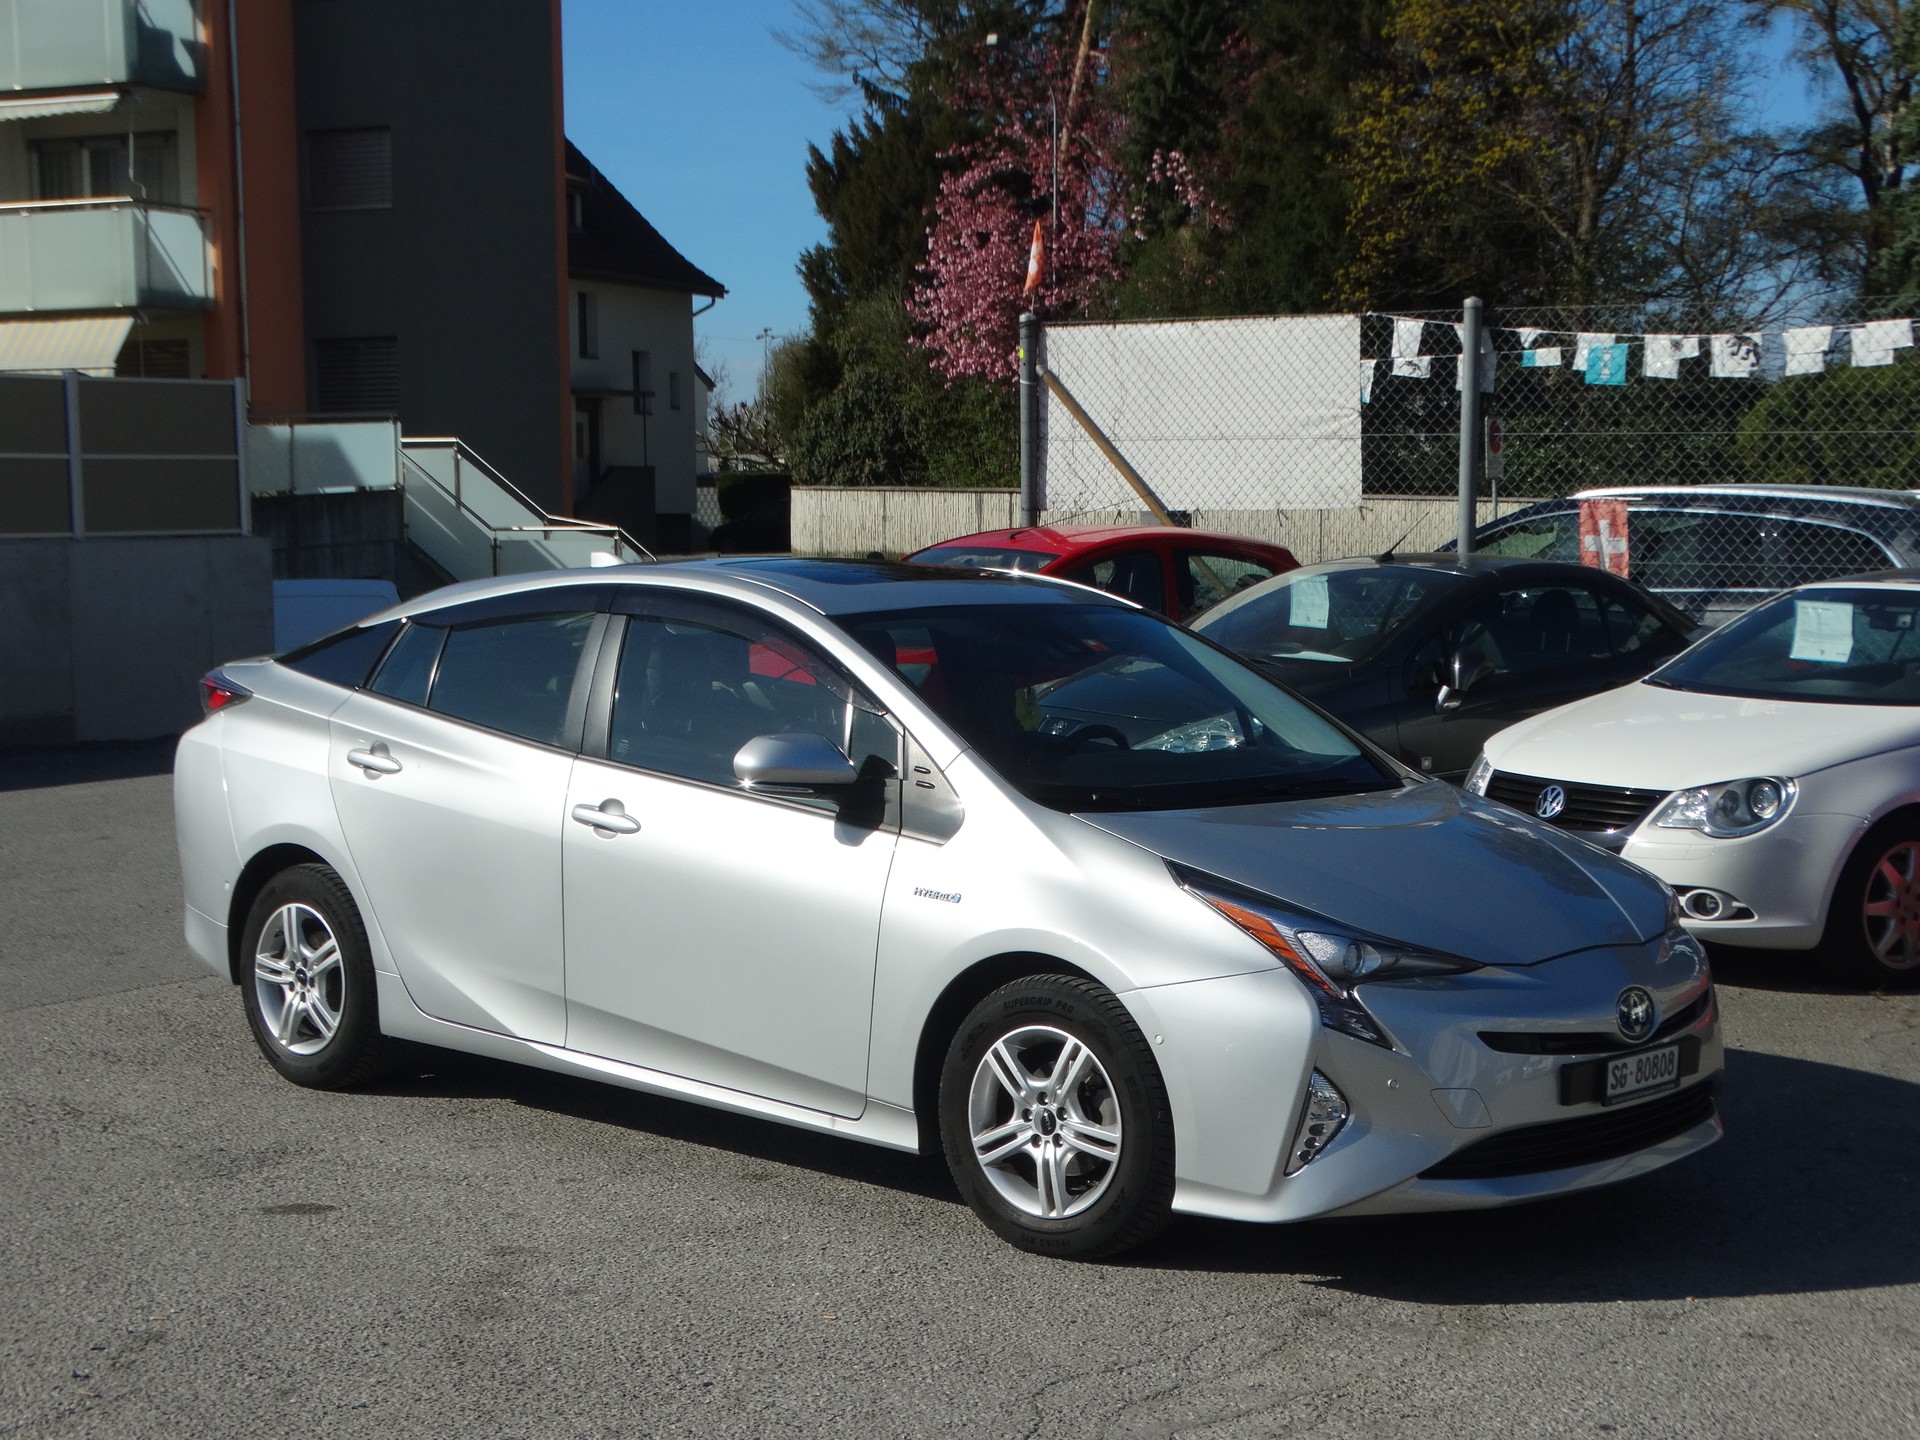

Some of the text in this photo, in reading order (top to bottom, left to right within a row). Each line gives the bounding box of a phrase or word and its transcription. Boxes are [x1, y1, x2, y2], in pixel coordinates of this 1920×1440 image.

[1003, 996, 1074, 1014] SUPERGRIP PRO
[1610, 1050, 1675, 1091] SG 80808
